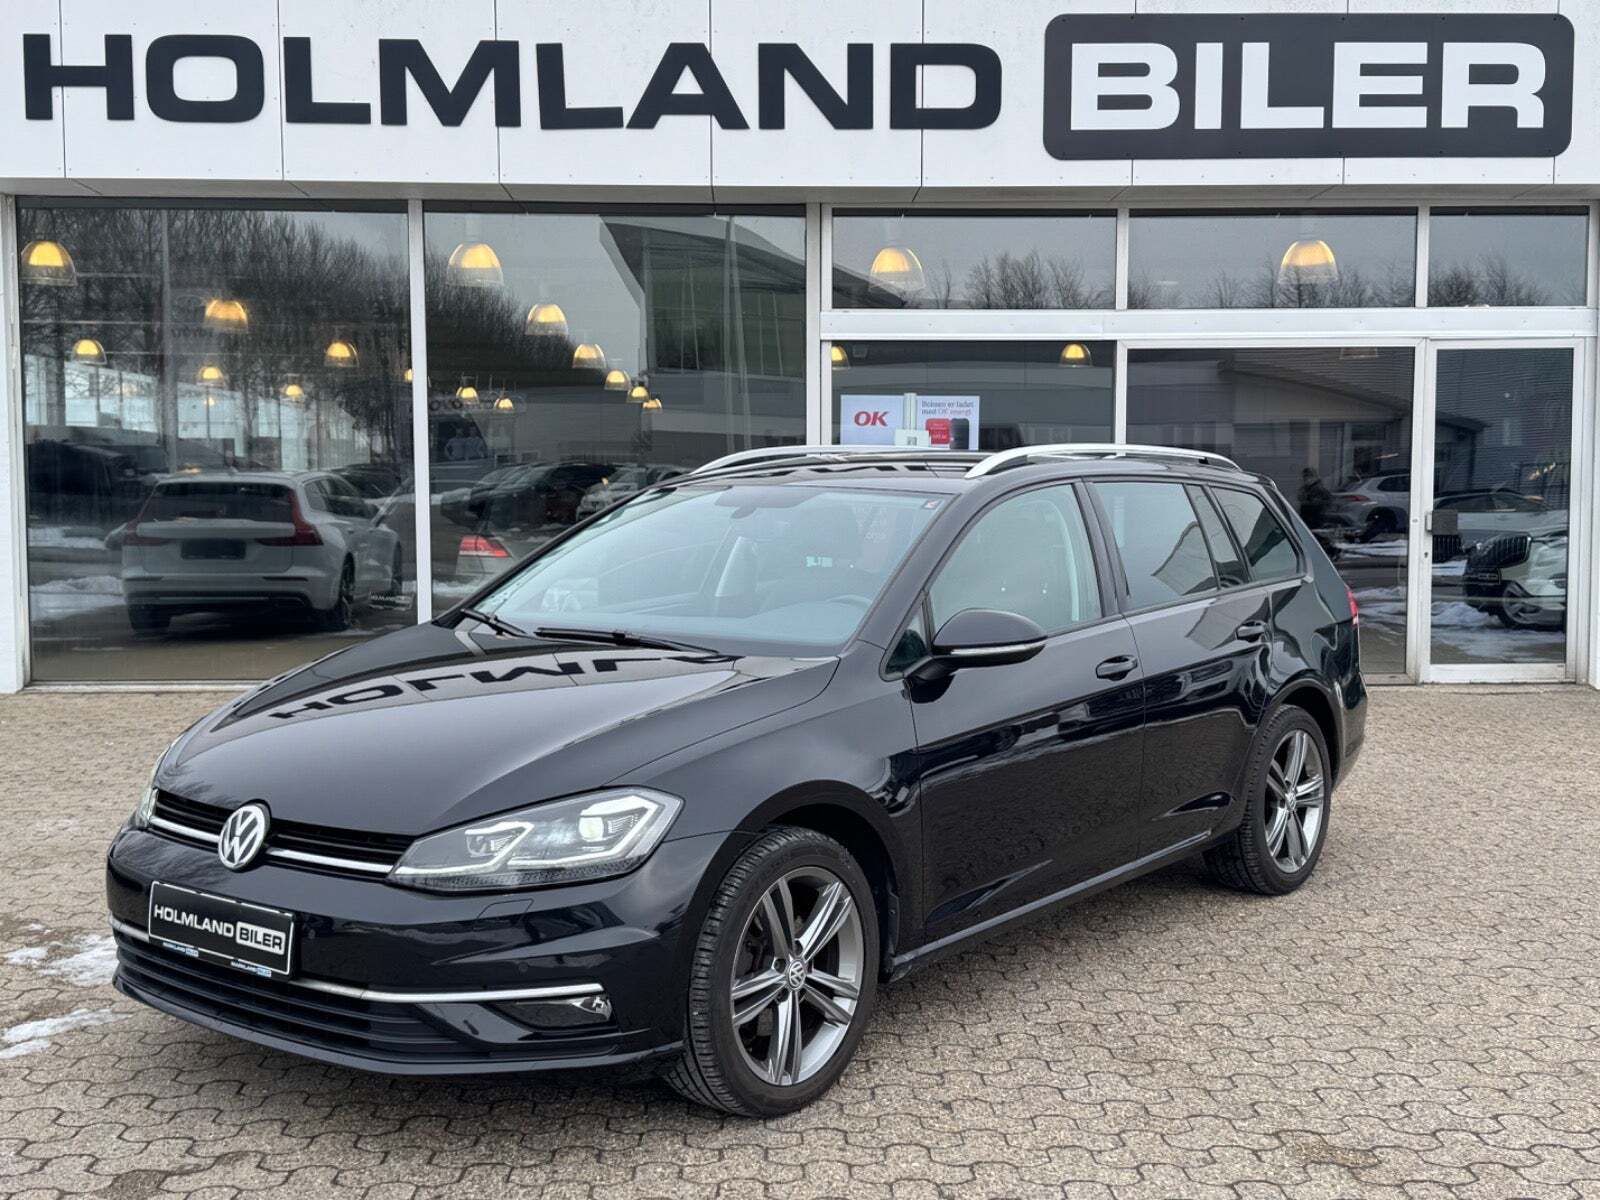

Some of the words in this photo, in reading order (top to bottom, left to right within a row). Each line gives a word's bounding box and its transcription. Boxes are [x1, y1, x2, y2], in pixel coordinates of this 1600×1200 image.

[23, 34, 1003, 130] HOLMLAND
[1070, 42, 1546, 130] BILER
[854, 411, 889, 427] OK
[154, 904, 234, 938] HOLMLAND
[240, 927, 283, 951] BILER
